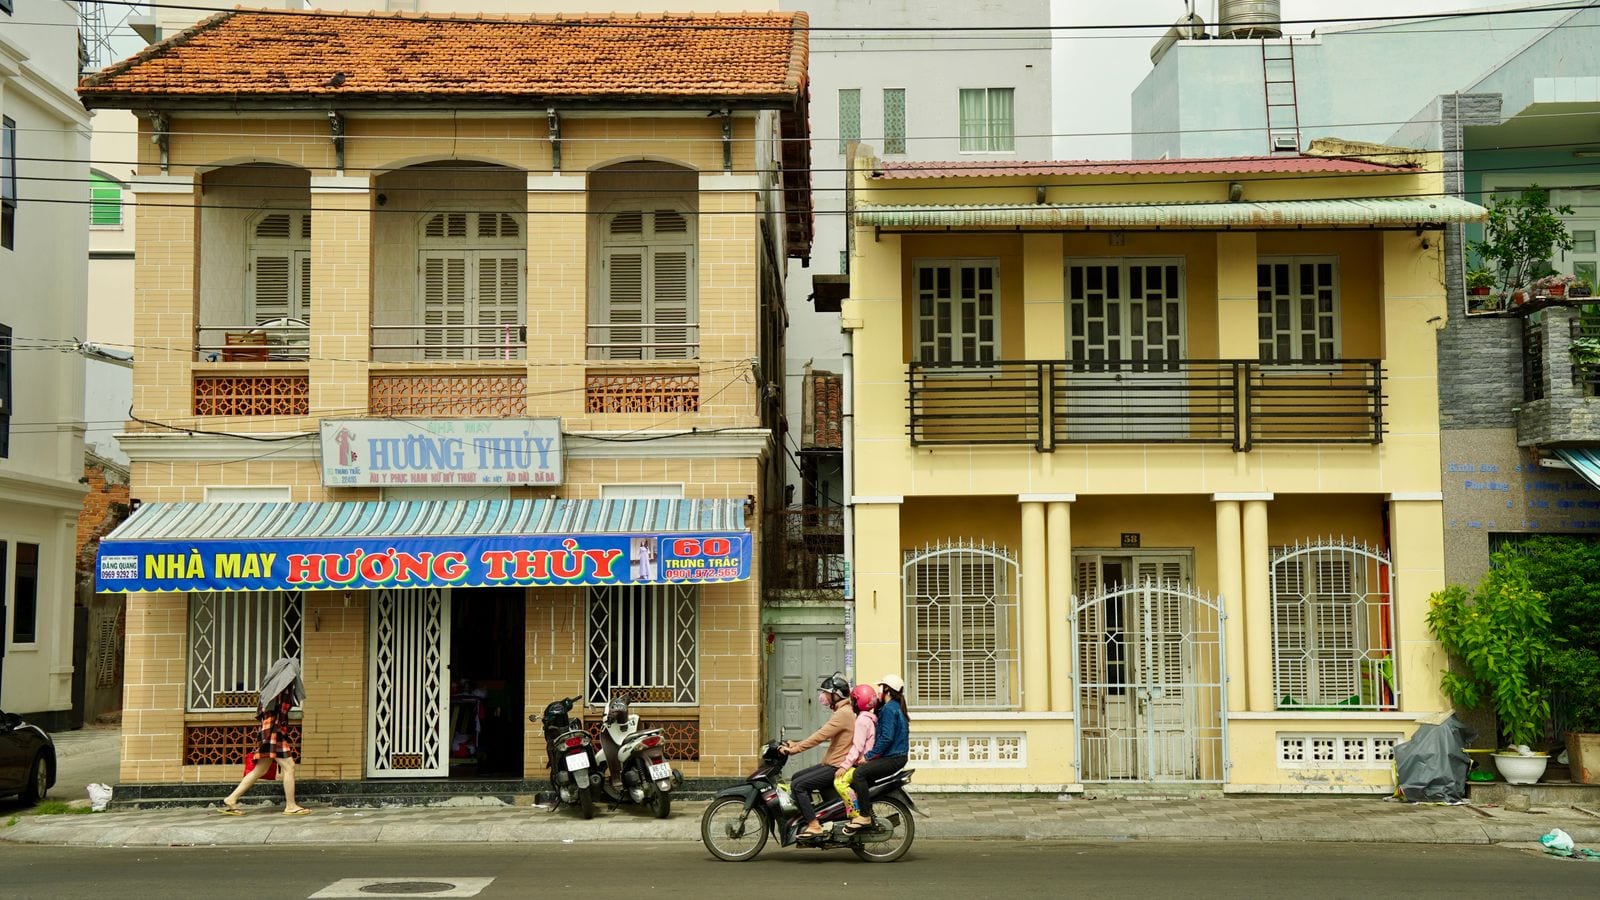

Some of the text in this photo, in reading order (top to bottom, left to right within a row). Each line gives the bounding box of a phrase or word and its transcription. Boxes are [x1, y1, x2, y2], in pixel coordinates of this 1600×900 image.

[464, 422, 493, 433] MAY
[368, 430, 555, 470] HƯƠNG THỦY
[1124, 534, 1137, 543] 58
[673, 538, 731, 557] 60
[119, 562, 136, 570] QUANG
[145, 538, 622, 583] NHÀ MAY HƯƠNG THỦY
